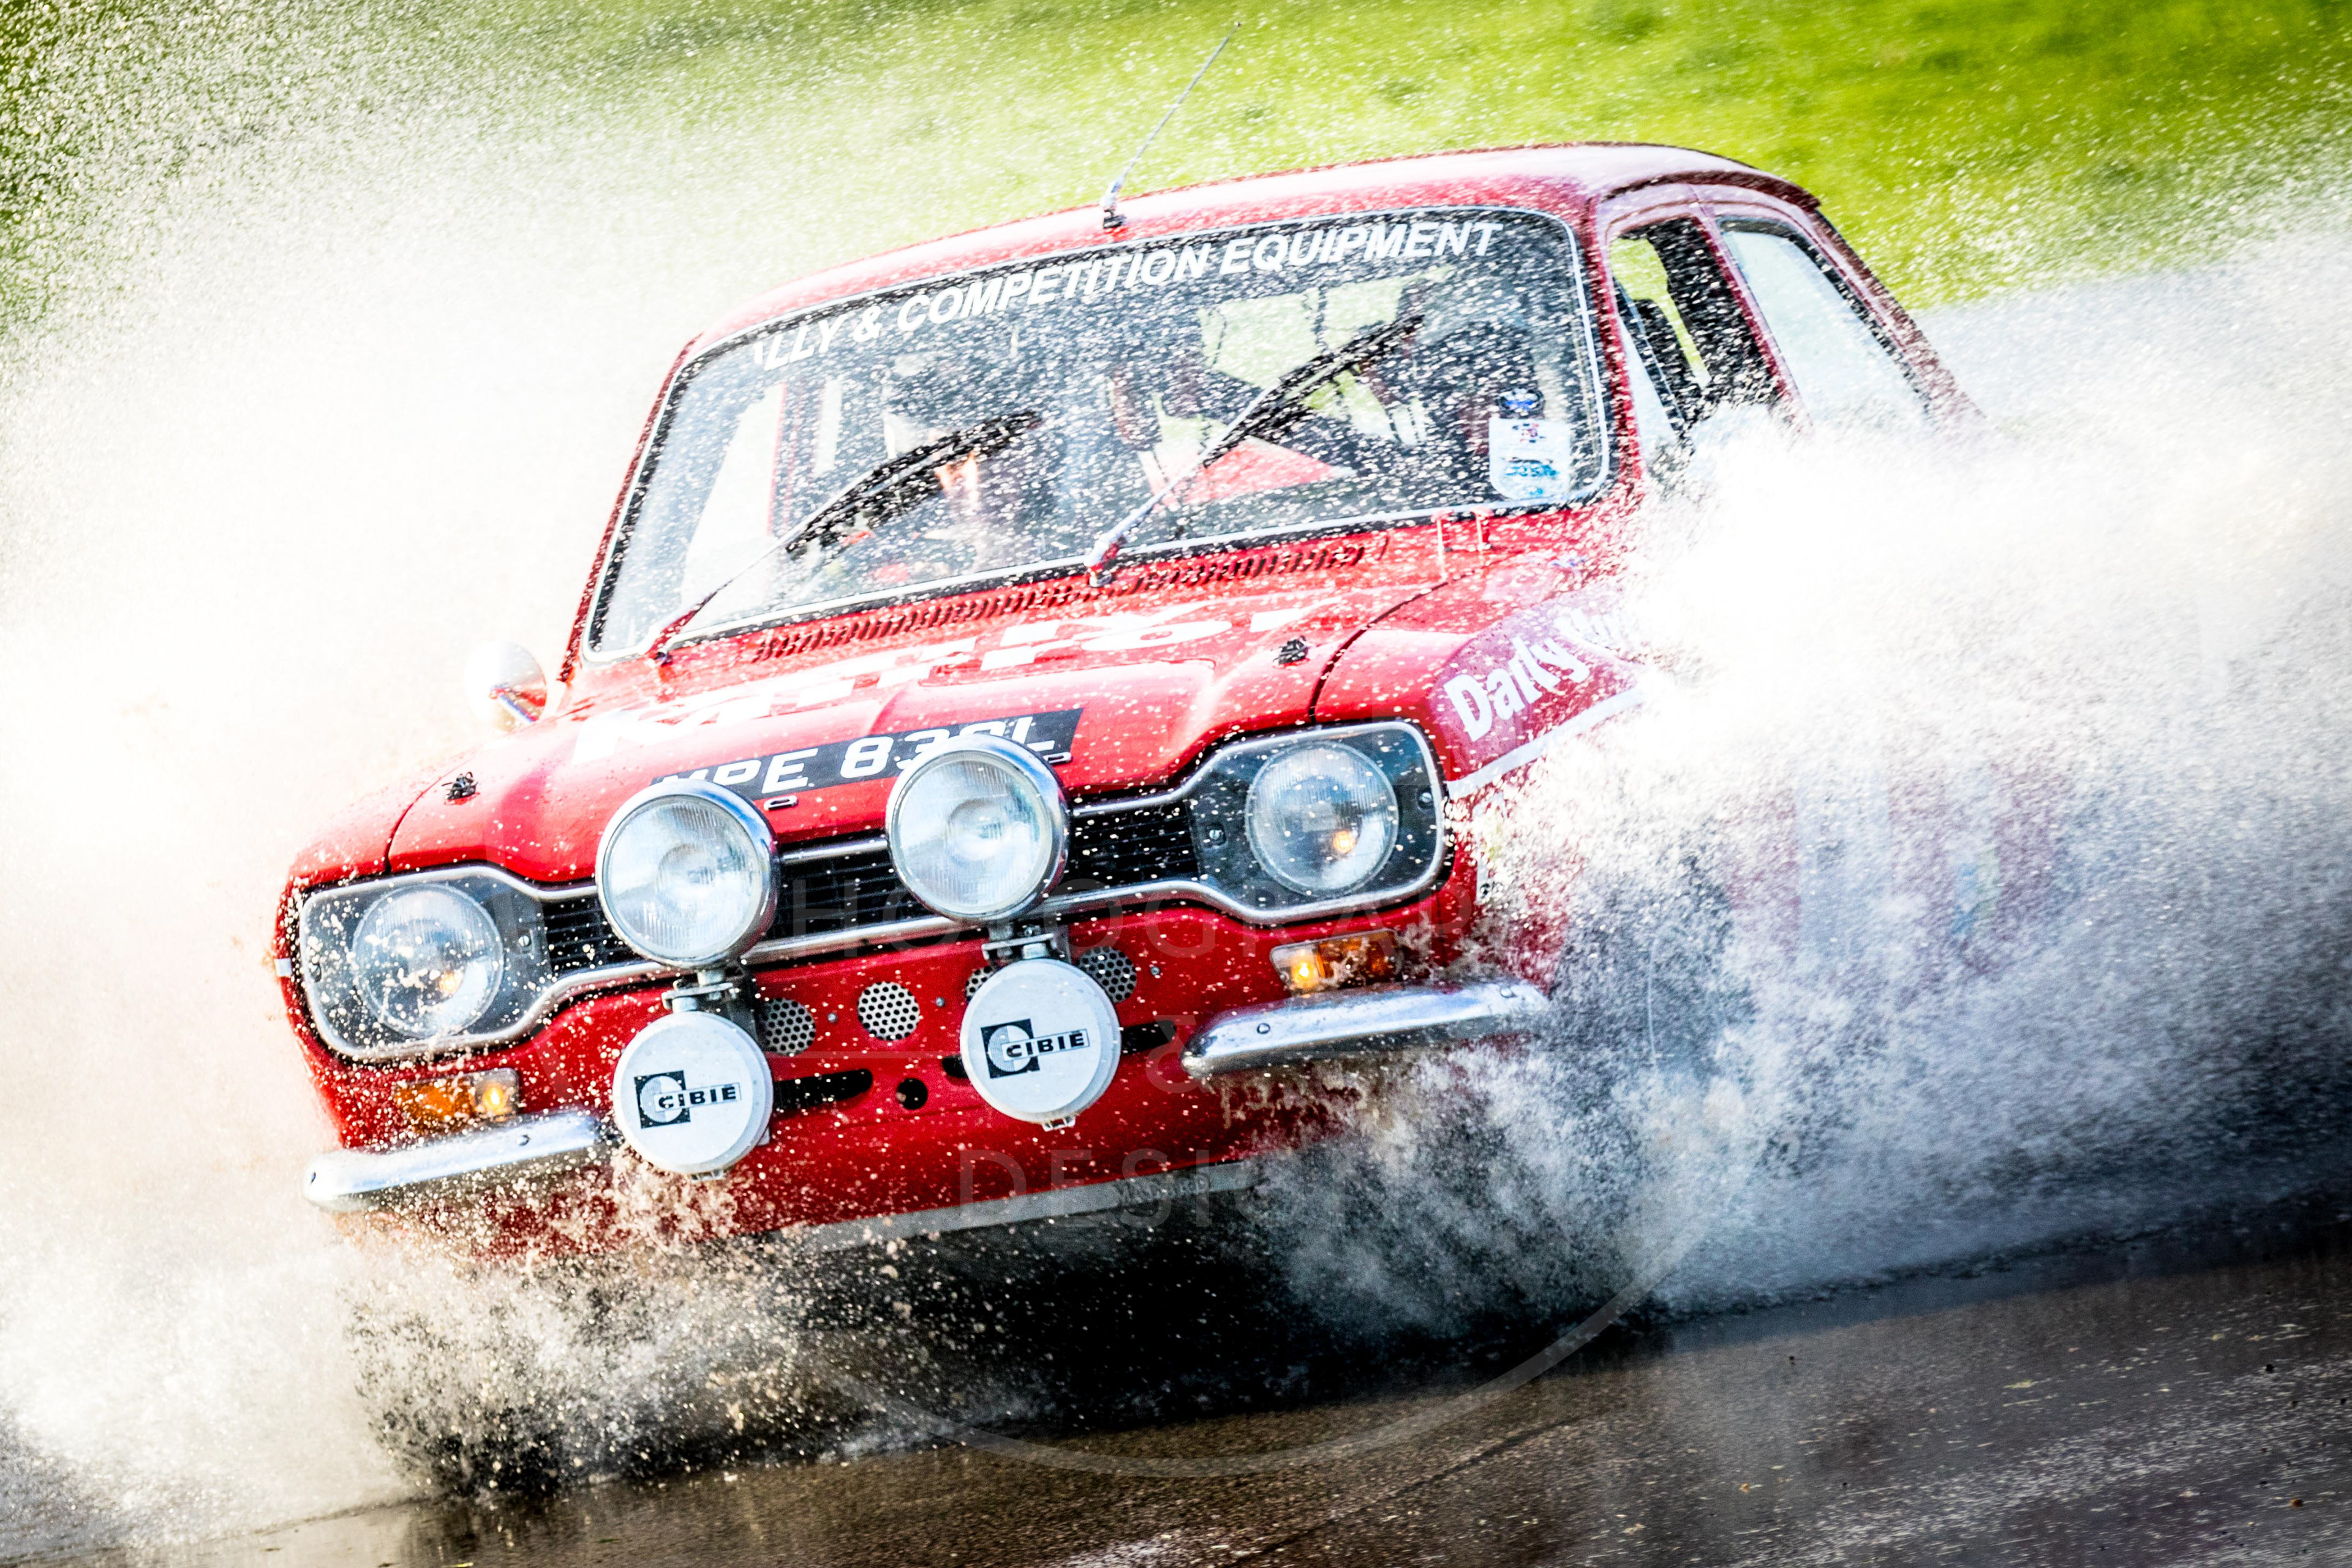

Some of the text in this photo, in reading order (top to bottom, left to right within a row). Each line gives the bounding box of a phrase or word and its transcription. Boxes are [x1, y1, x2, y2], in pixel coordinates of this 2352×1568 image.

[854, 305, 883, 343] &
[897, 243, 1212, 332] COMPETITION
[1219, 221, 1504, 276] EQUIPMENT
[662, 748, 819, 794] PE
